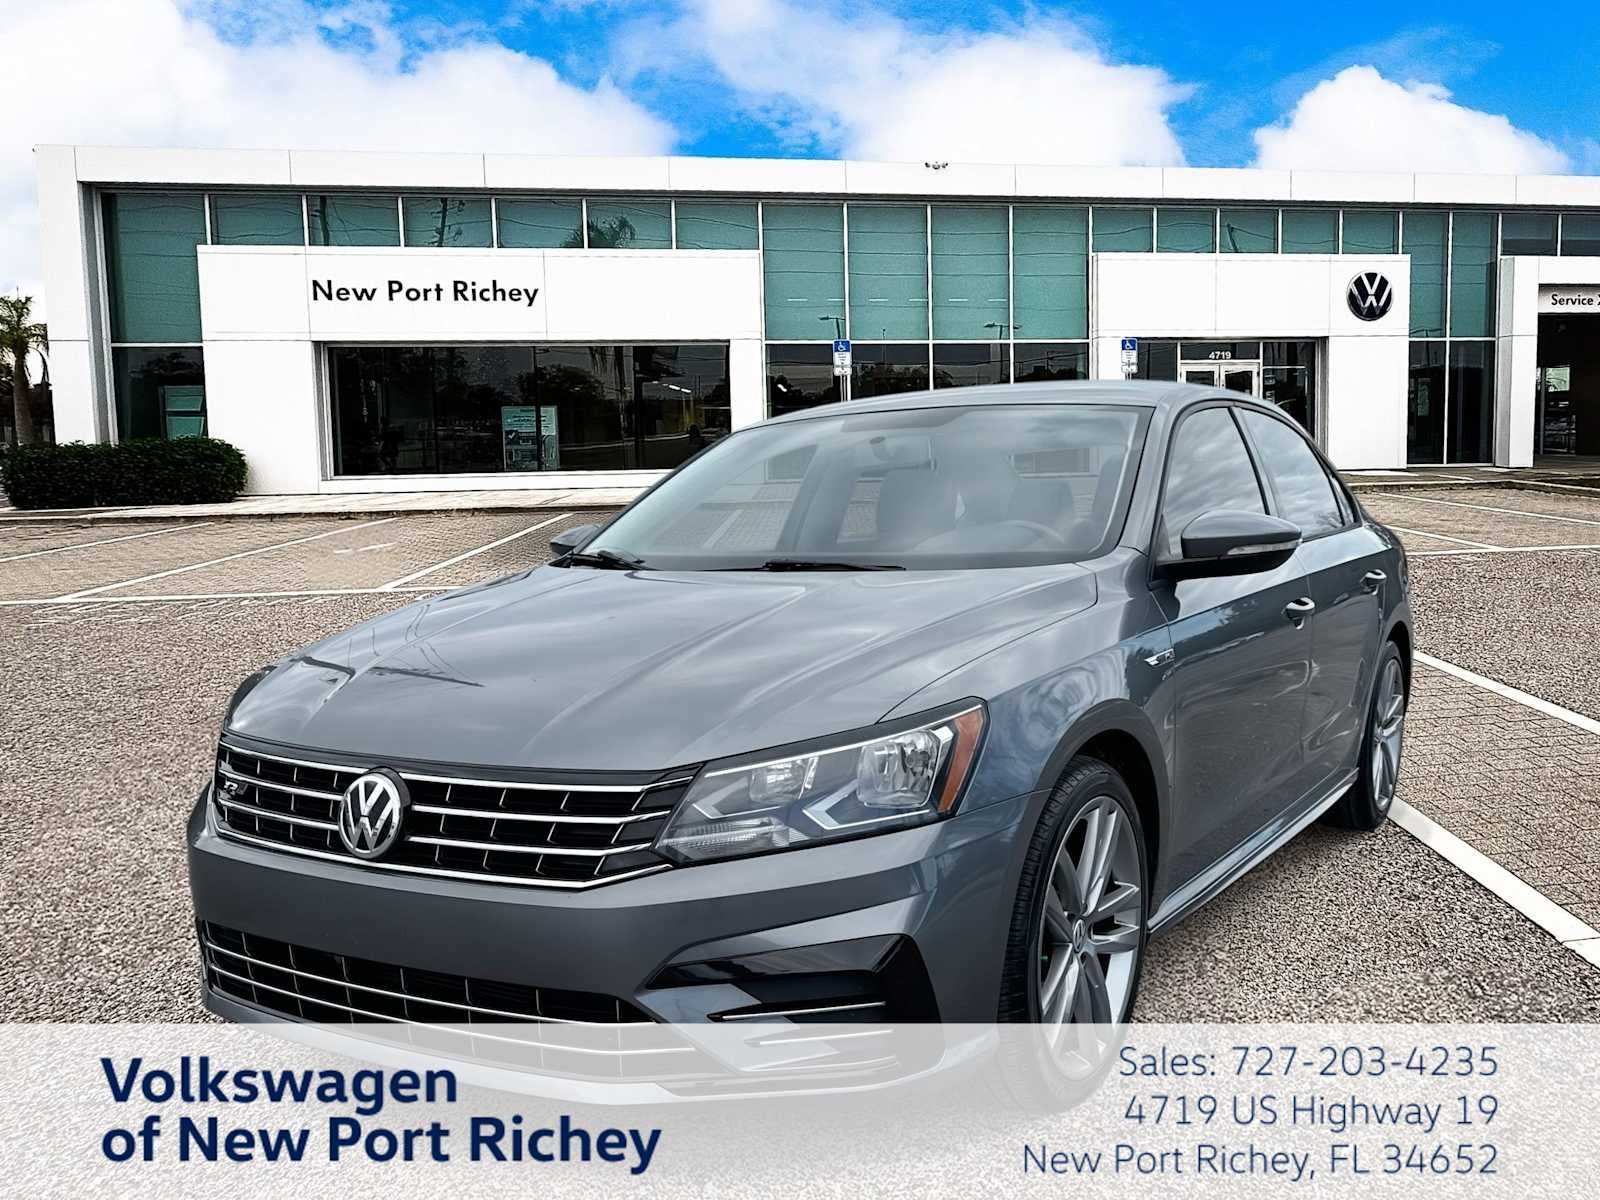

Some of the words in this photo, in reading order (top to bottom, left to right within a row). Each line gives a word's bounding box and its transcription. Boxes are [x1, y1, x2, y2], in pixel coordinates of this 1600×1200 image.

[312, 279, 377, 302] New
[387, 280, 444, 303] Port
[453, 279, 539, 307] Richey
[1347, 271, 1393, 321] VW
[1551, 293, 1594, 306] Service
[1209, 351, 1232, 360] 4719
[338, 773, 402, 858] VW
